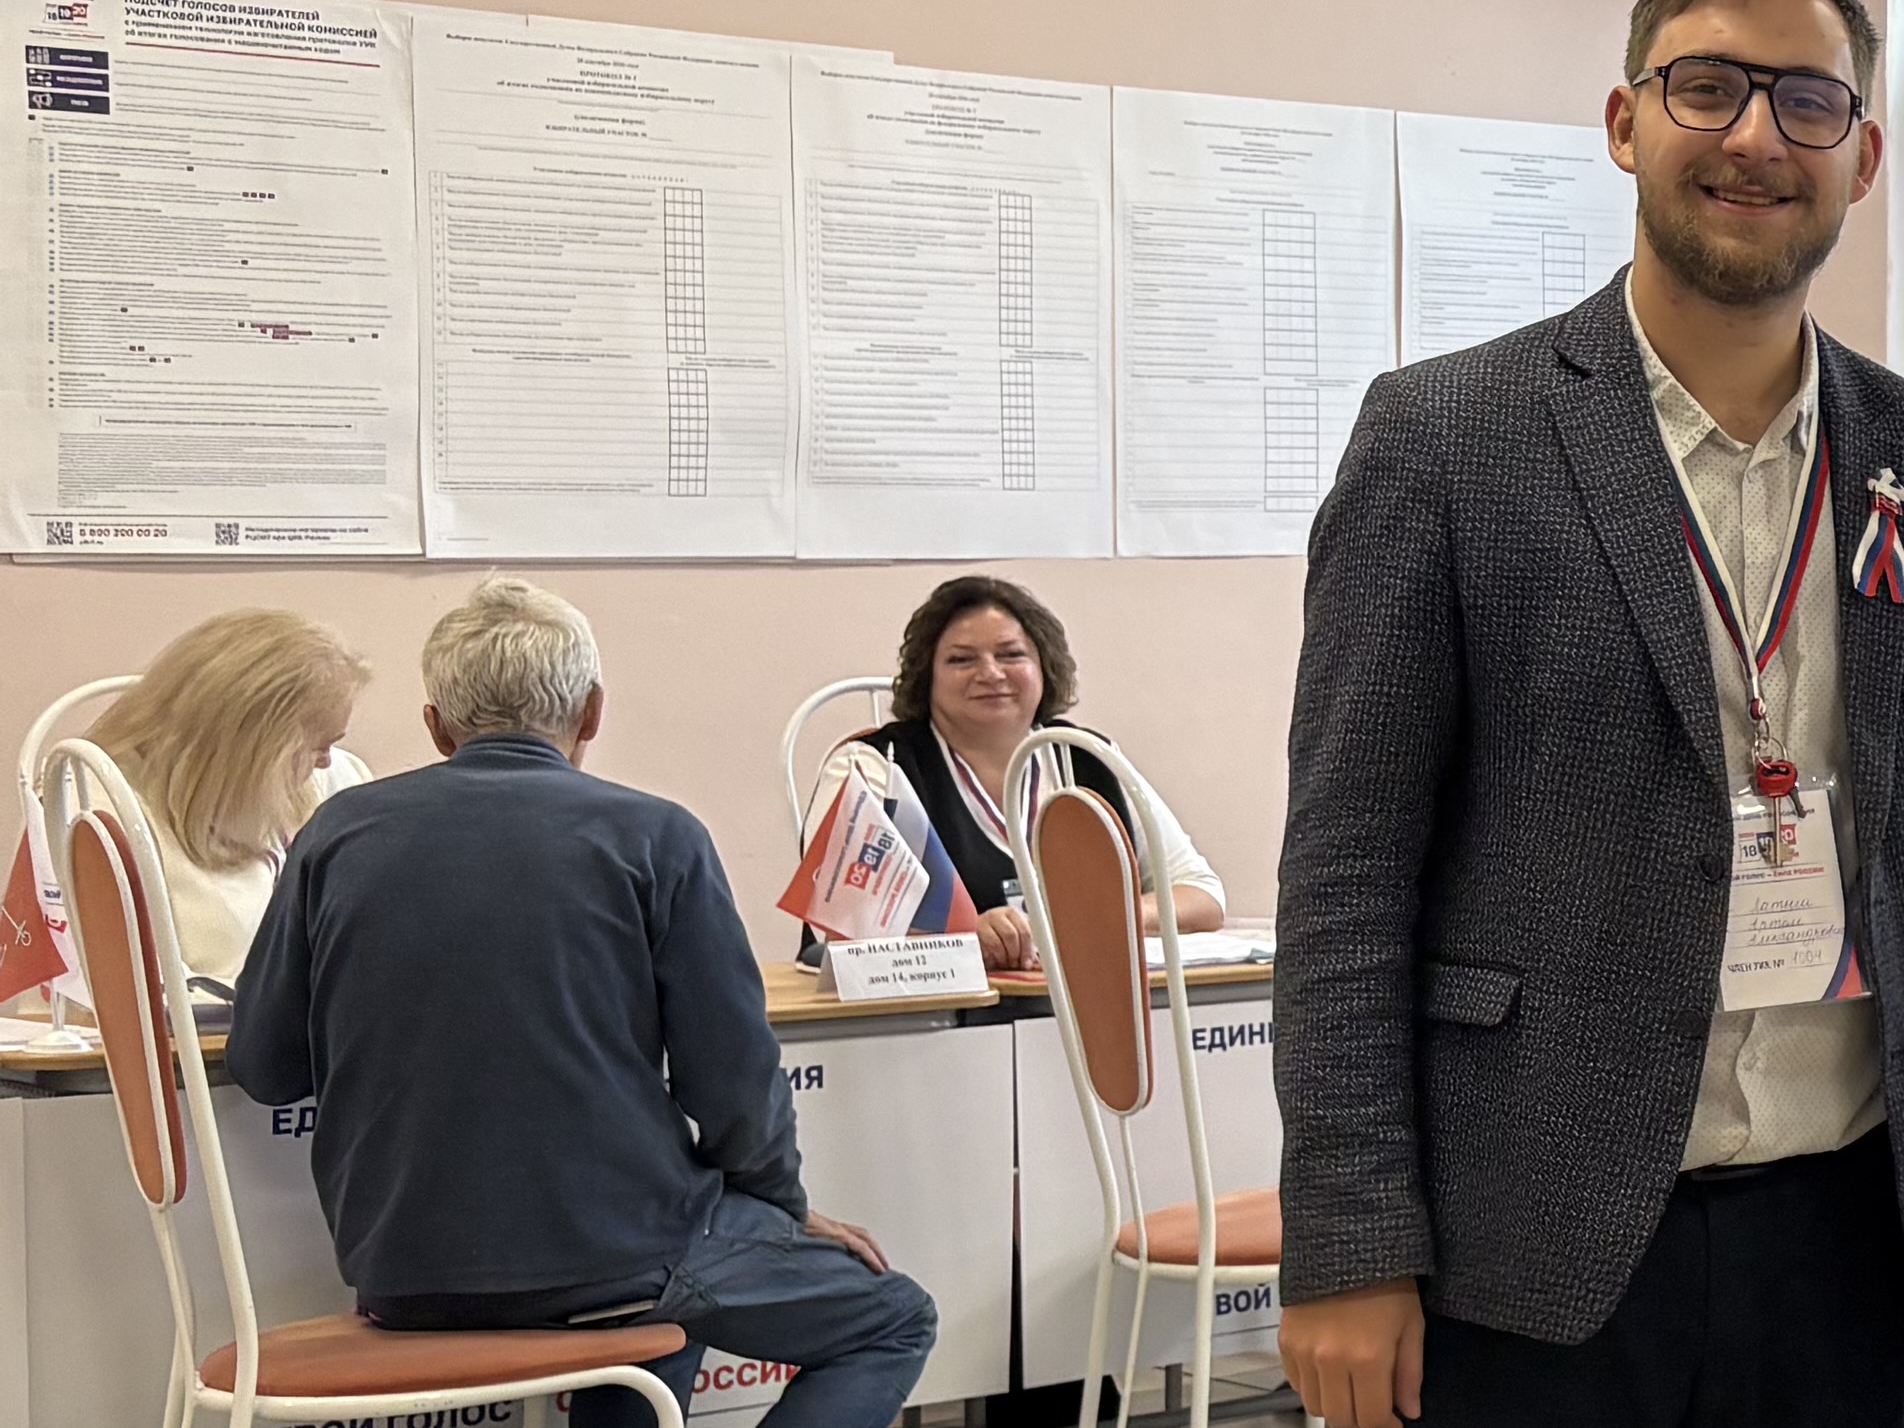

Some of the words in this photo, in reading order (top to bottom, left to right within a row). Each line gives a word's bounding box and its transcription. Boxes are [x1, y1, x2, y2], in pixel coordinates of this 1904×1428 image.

[868, 939, 964, 954] НАСТАВНИКОВ
[892, 957, 913, 968] дом
[915, 955, 927, 966] 12
[868, 975, 889, 985] дом
[909, 969, 947, 983] корпус
[950, 968, 956, 979] 1
[1215, 1282, 1272, 1317] ВОЙ
[692, 1360, 798, 1394] ОССИ
